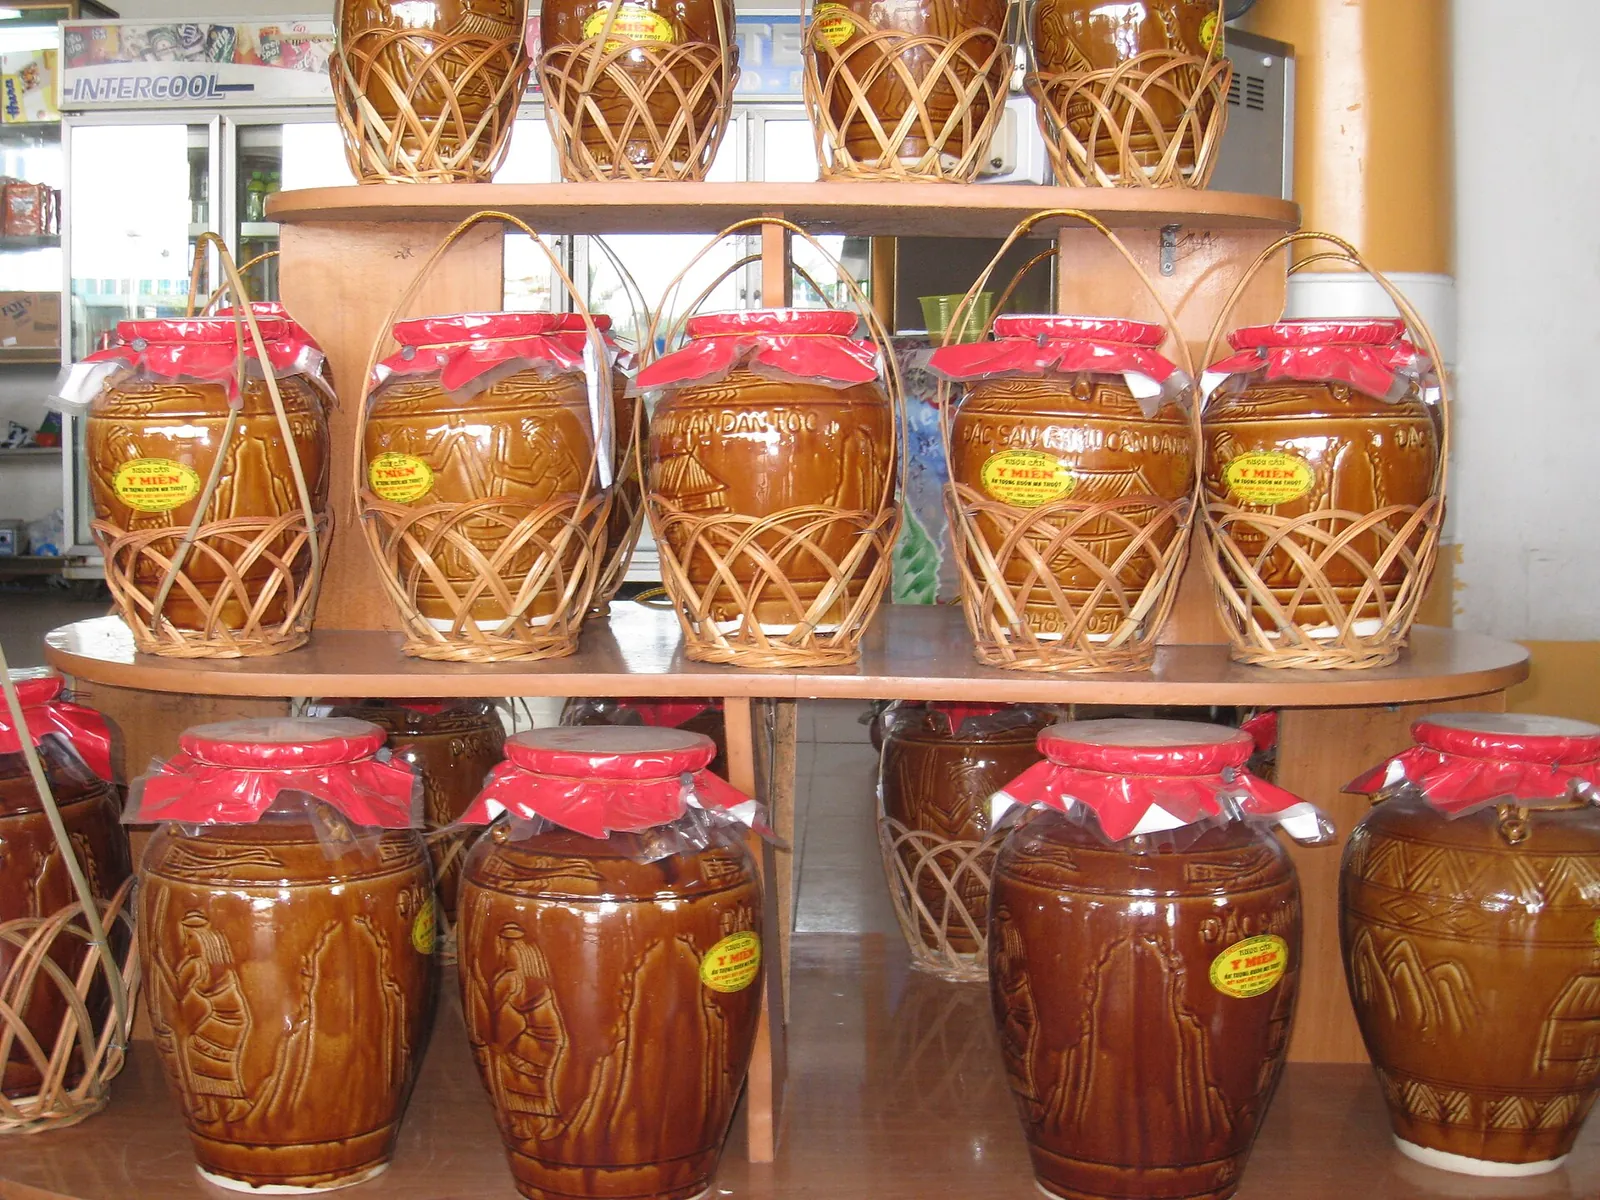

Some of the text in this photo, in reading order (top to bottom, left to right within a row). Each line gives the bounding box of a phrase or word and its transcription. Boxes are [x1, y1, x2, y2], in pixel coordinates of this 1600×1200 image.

[73, 74, 224, 100] INTERCOOL
[997, 467, 1006, 477] Y
[1239, 468, 1248, 477] Y
[126, 476, 136, 485] Y
[717, 955, 726, 966] Y
[1231, 959, 1241, 970] Y
